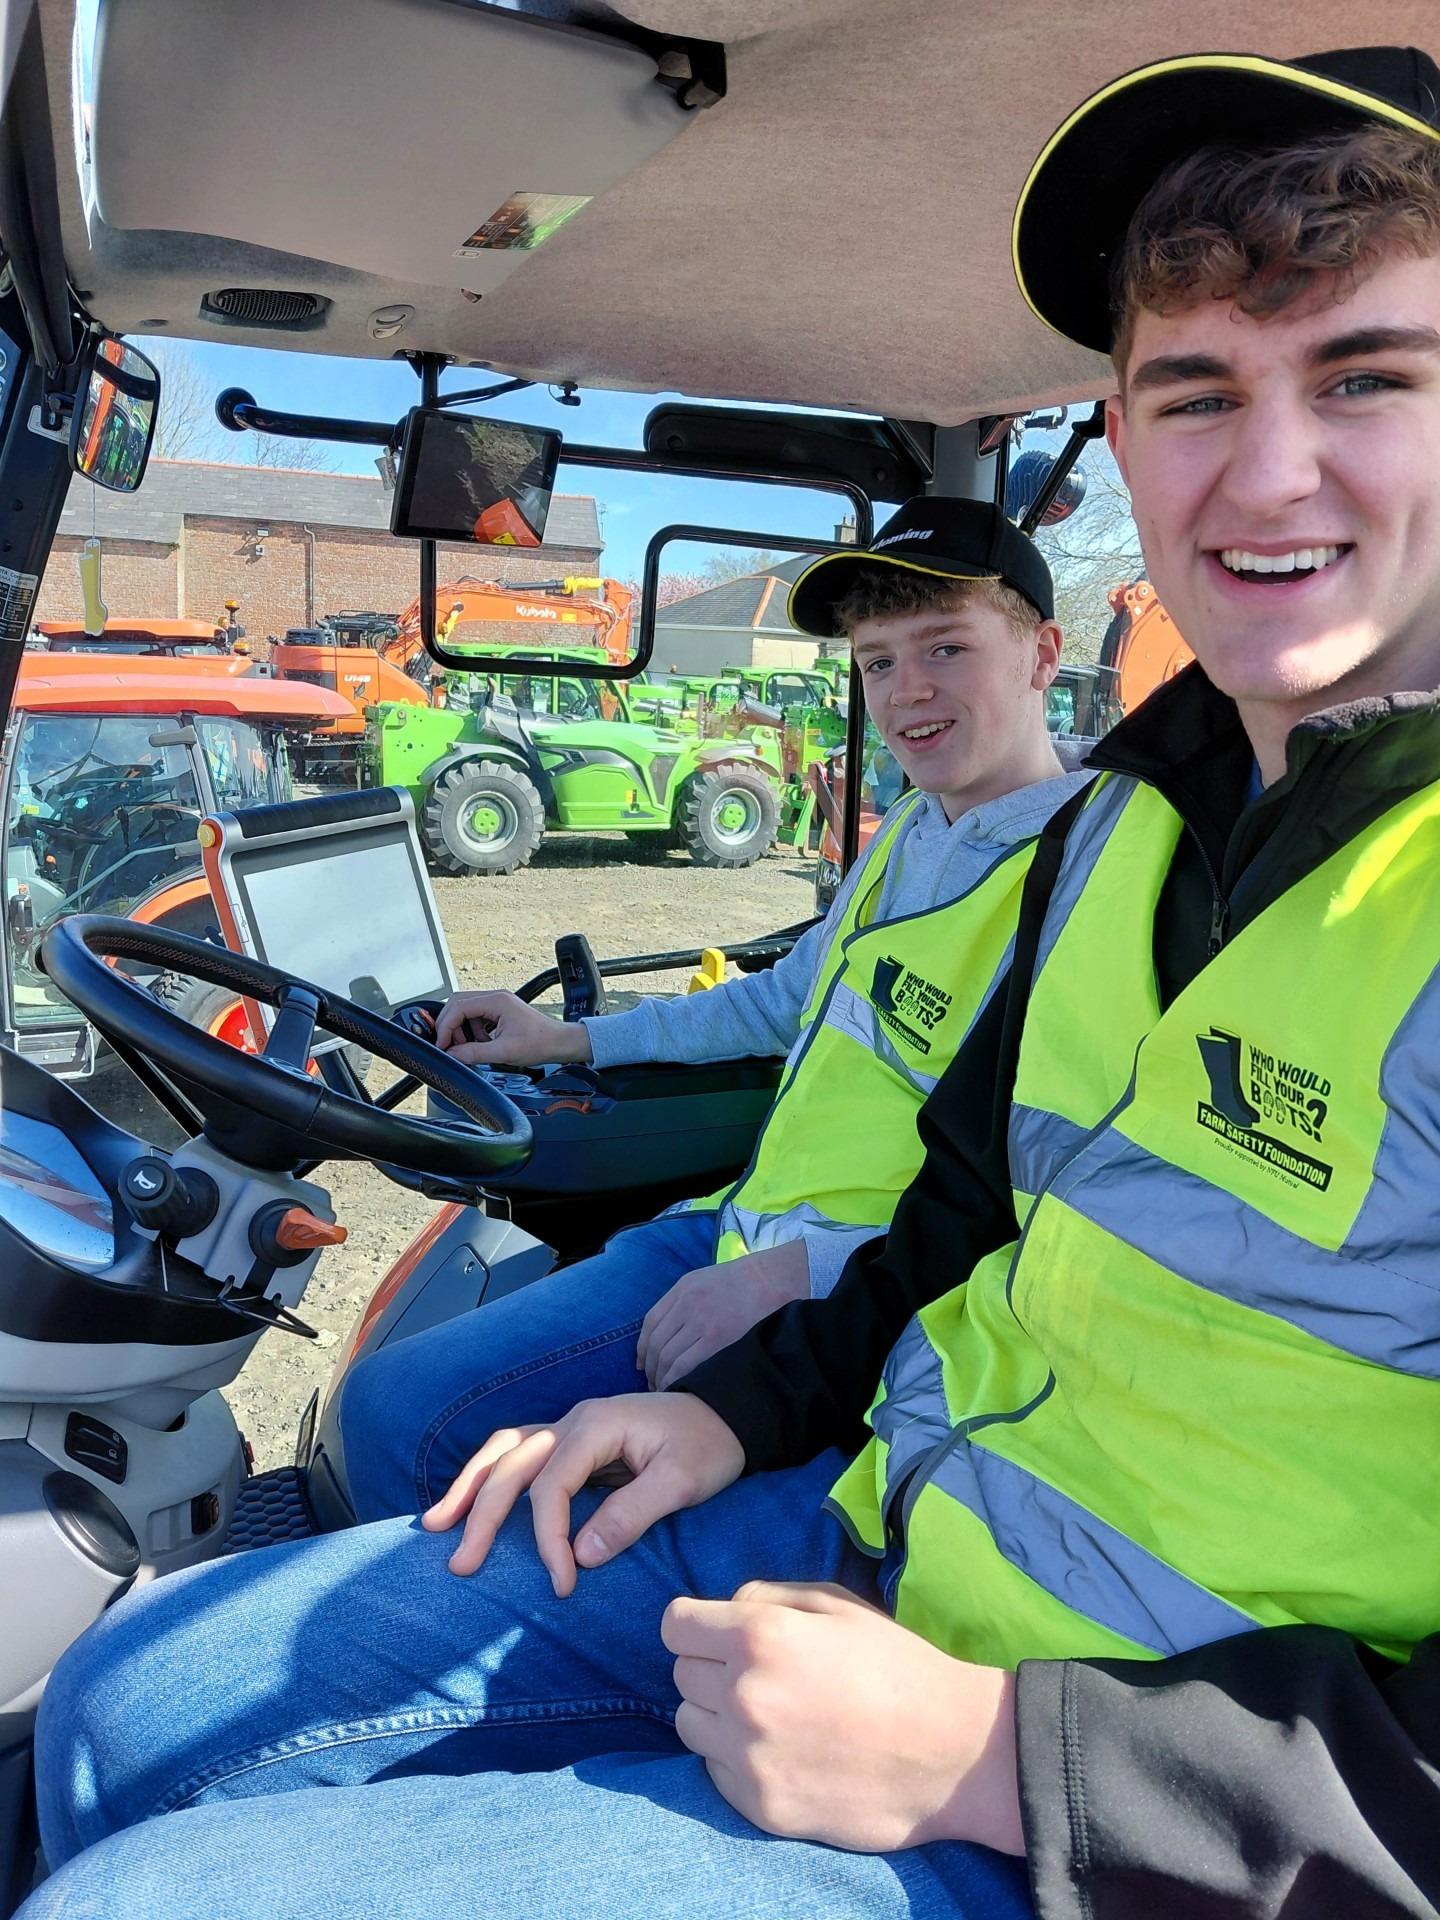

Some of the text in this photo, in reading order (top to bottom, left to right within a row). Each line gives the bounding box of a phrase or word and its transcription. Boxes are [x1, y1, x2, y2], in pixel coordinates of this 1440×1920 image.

[902, 980, 938, 1009] FILL YOUR
[906, 970, 953, 1005] WHO WOULD
[895, 1022, 928, 1052] FOUNDATION
[1249, 1044, 1331, 1097] WHO WOULD
[1250, 1063, 1305, 1107] FILL YOUR
[1200, 1108, 1327, 1186] FARM SAFETY FOUNDATION
